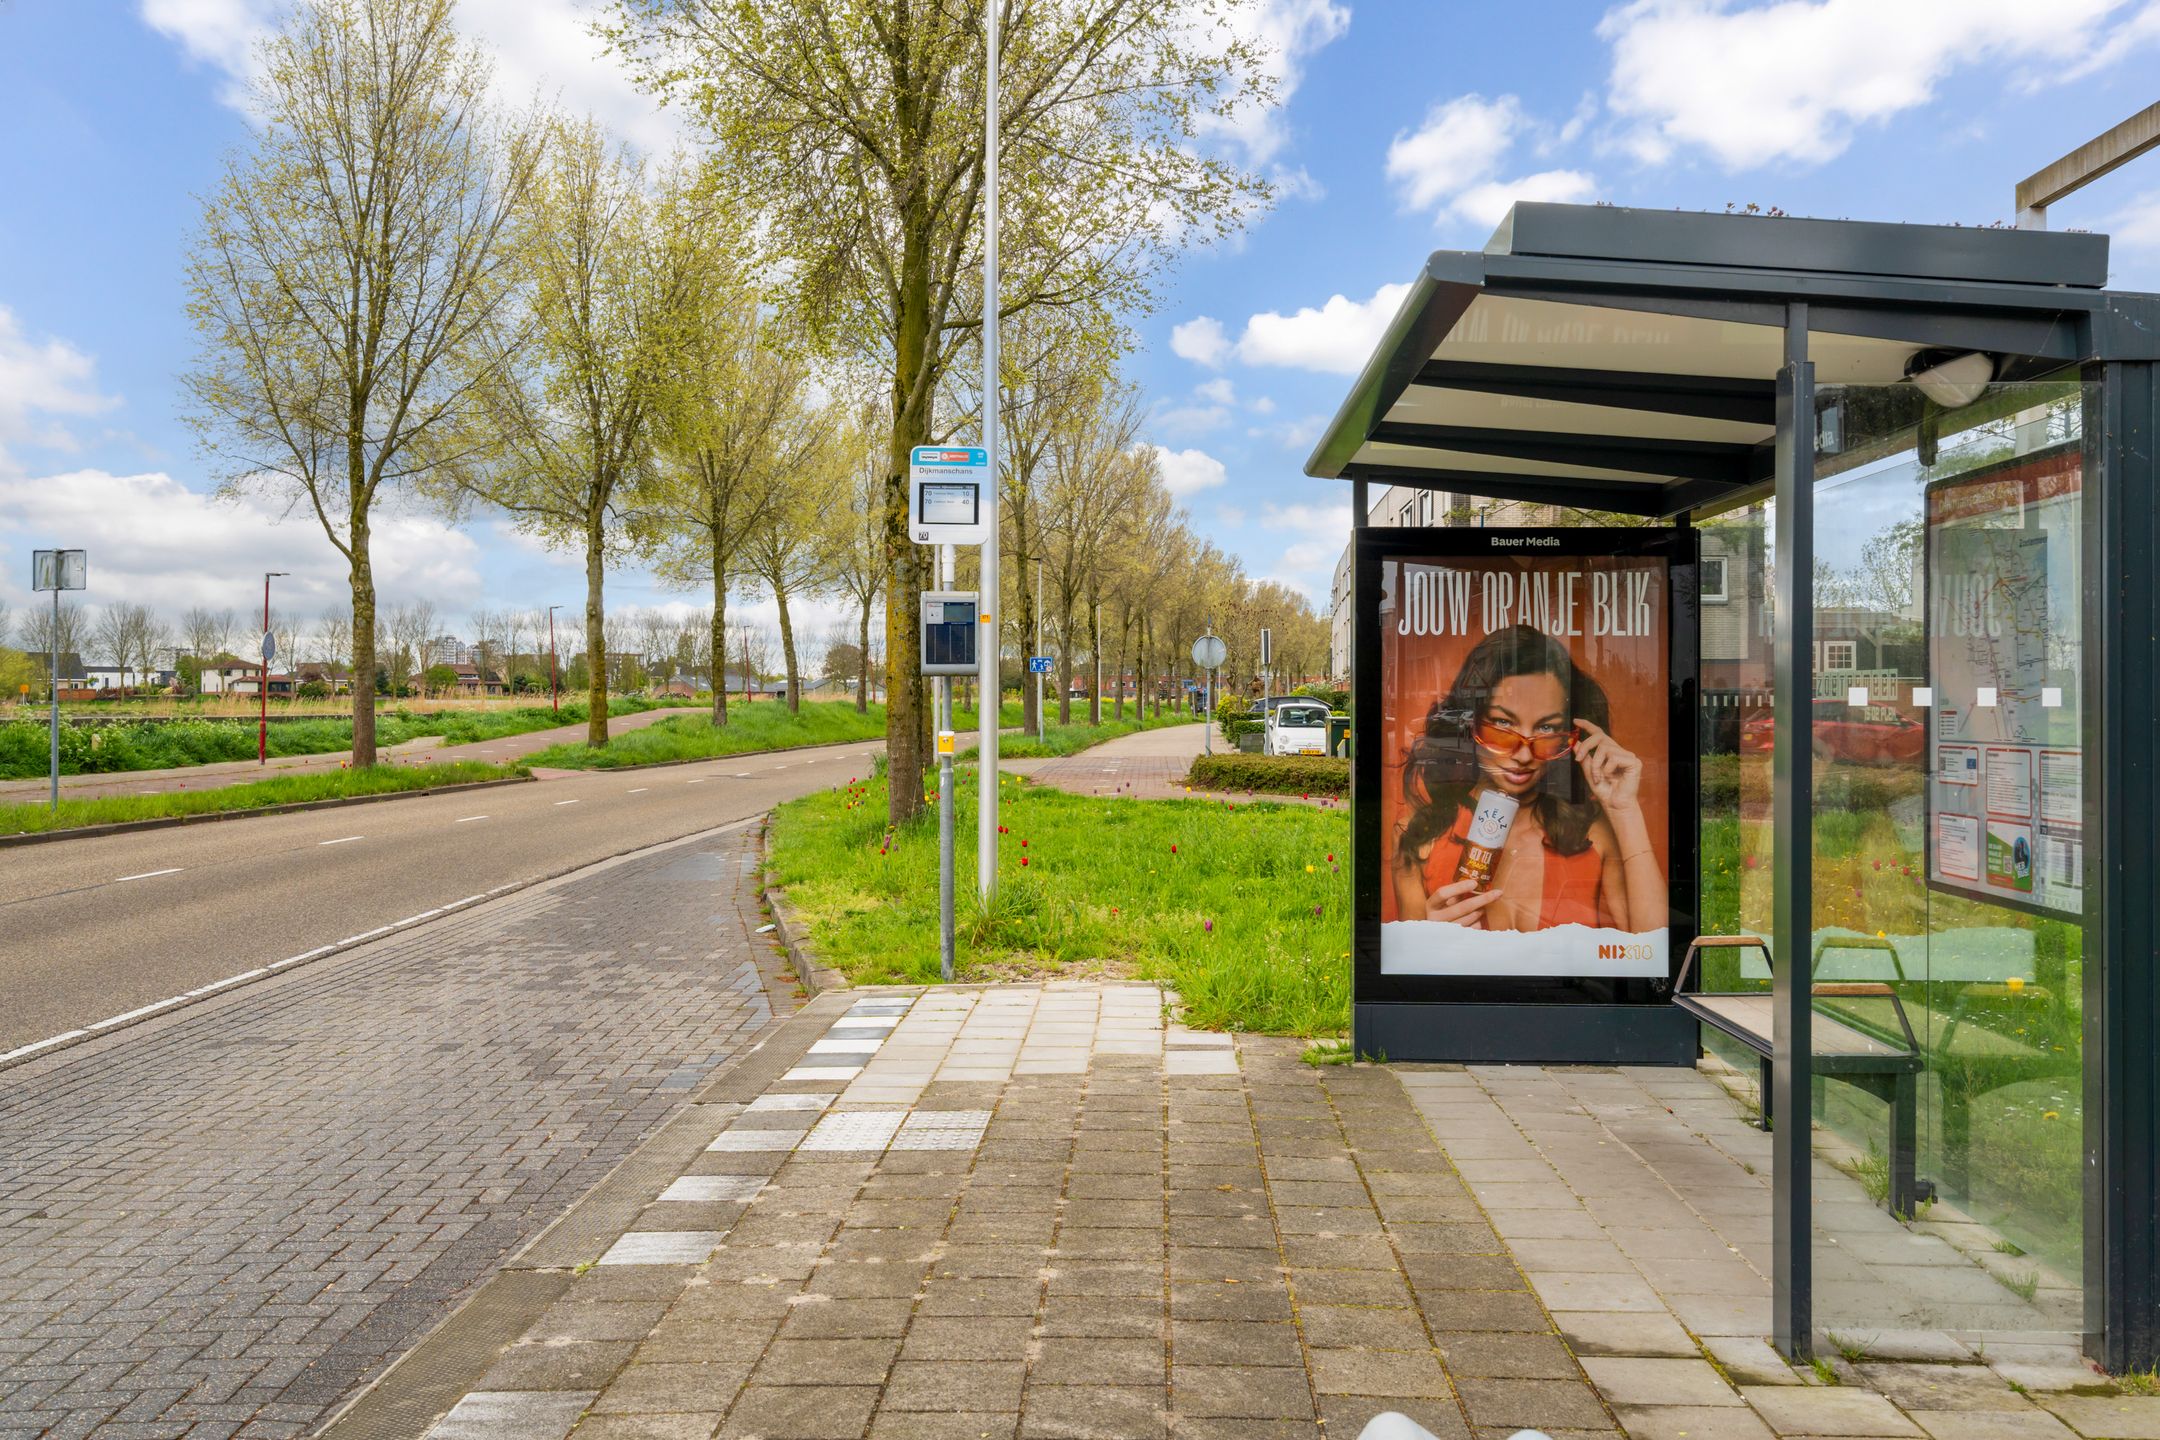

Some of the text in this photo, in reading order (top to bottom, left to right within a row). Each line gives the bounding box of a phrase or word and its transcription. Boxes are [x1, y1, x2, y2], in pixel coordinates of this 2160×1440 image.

[1814, 431, 1834, 452] edia
[919, 467, 973, 475] Dijkmanschans
[919, 531, 928, 540] 70
[1491, 536, 1561, 547] Bauer Media
[1398, 571, 1651, 637] JOUW ORANJE BLIK
